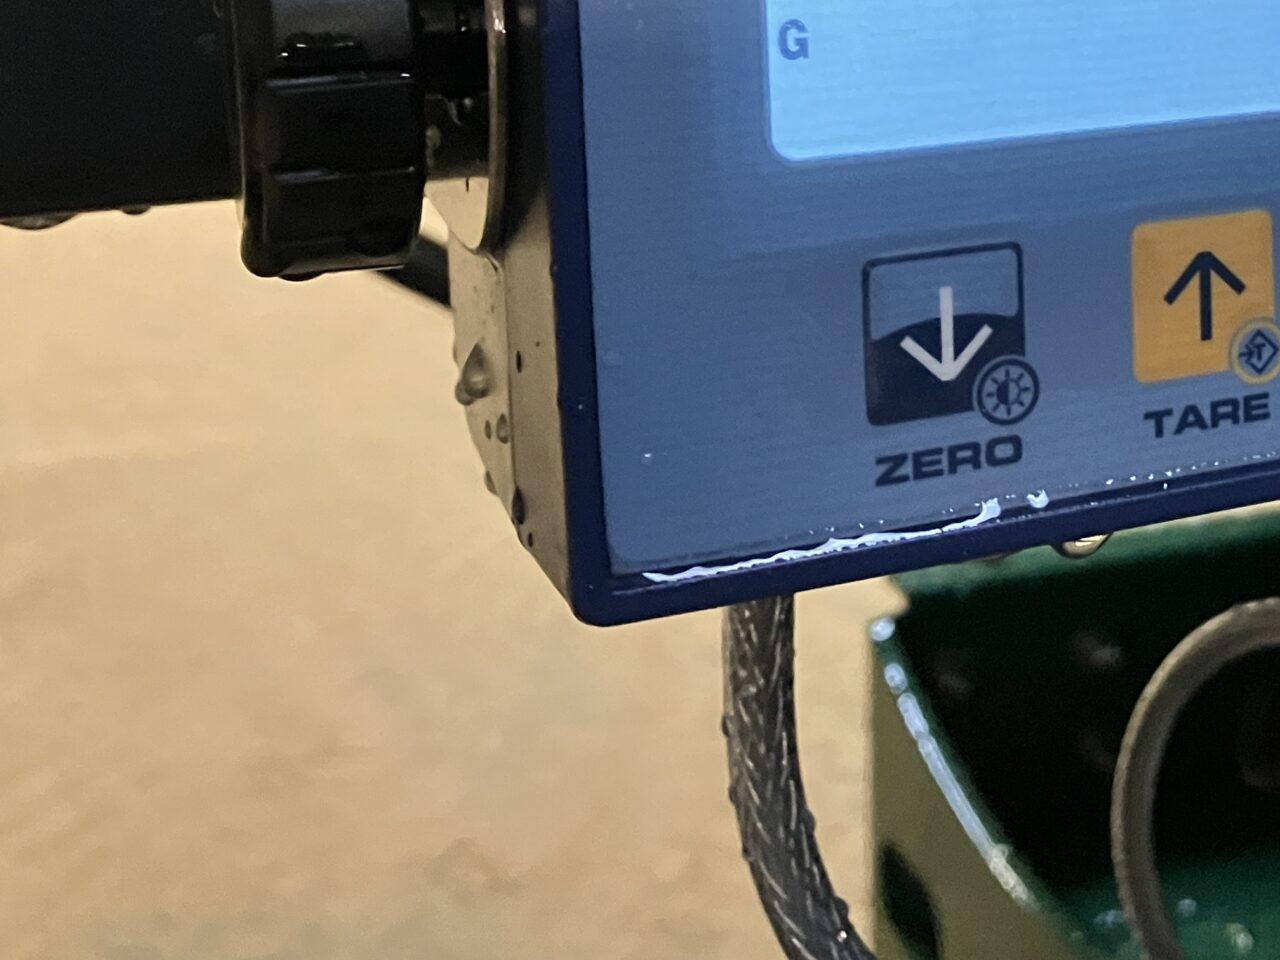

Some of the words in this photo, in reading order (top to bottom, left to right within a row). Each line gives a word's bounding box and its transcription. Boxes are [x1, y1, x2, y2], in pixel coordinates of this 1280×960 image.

[777, 18, 810, 61] G
[1143, 392, 1272, 439] TARE
[875, 434, 1023, 488] ZERO
